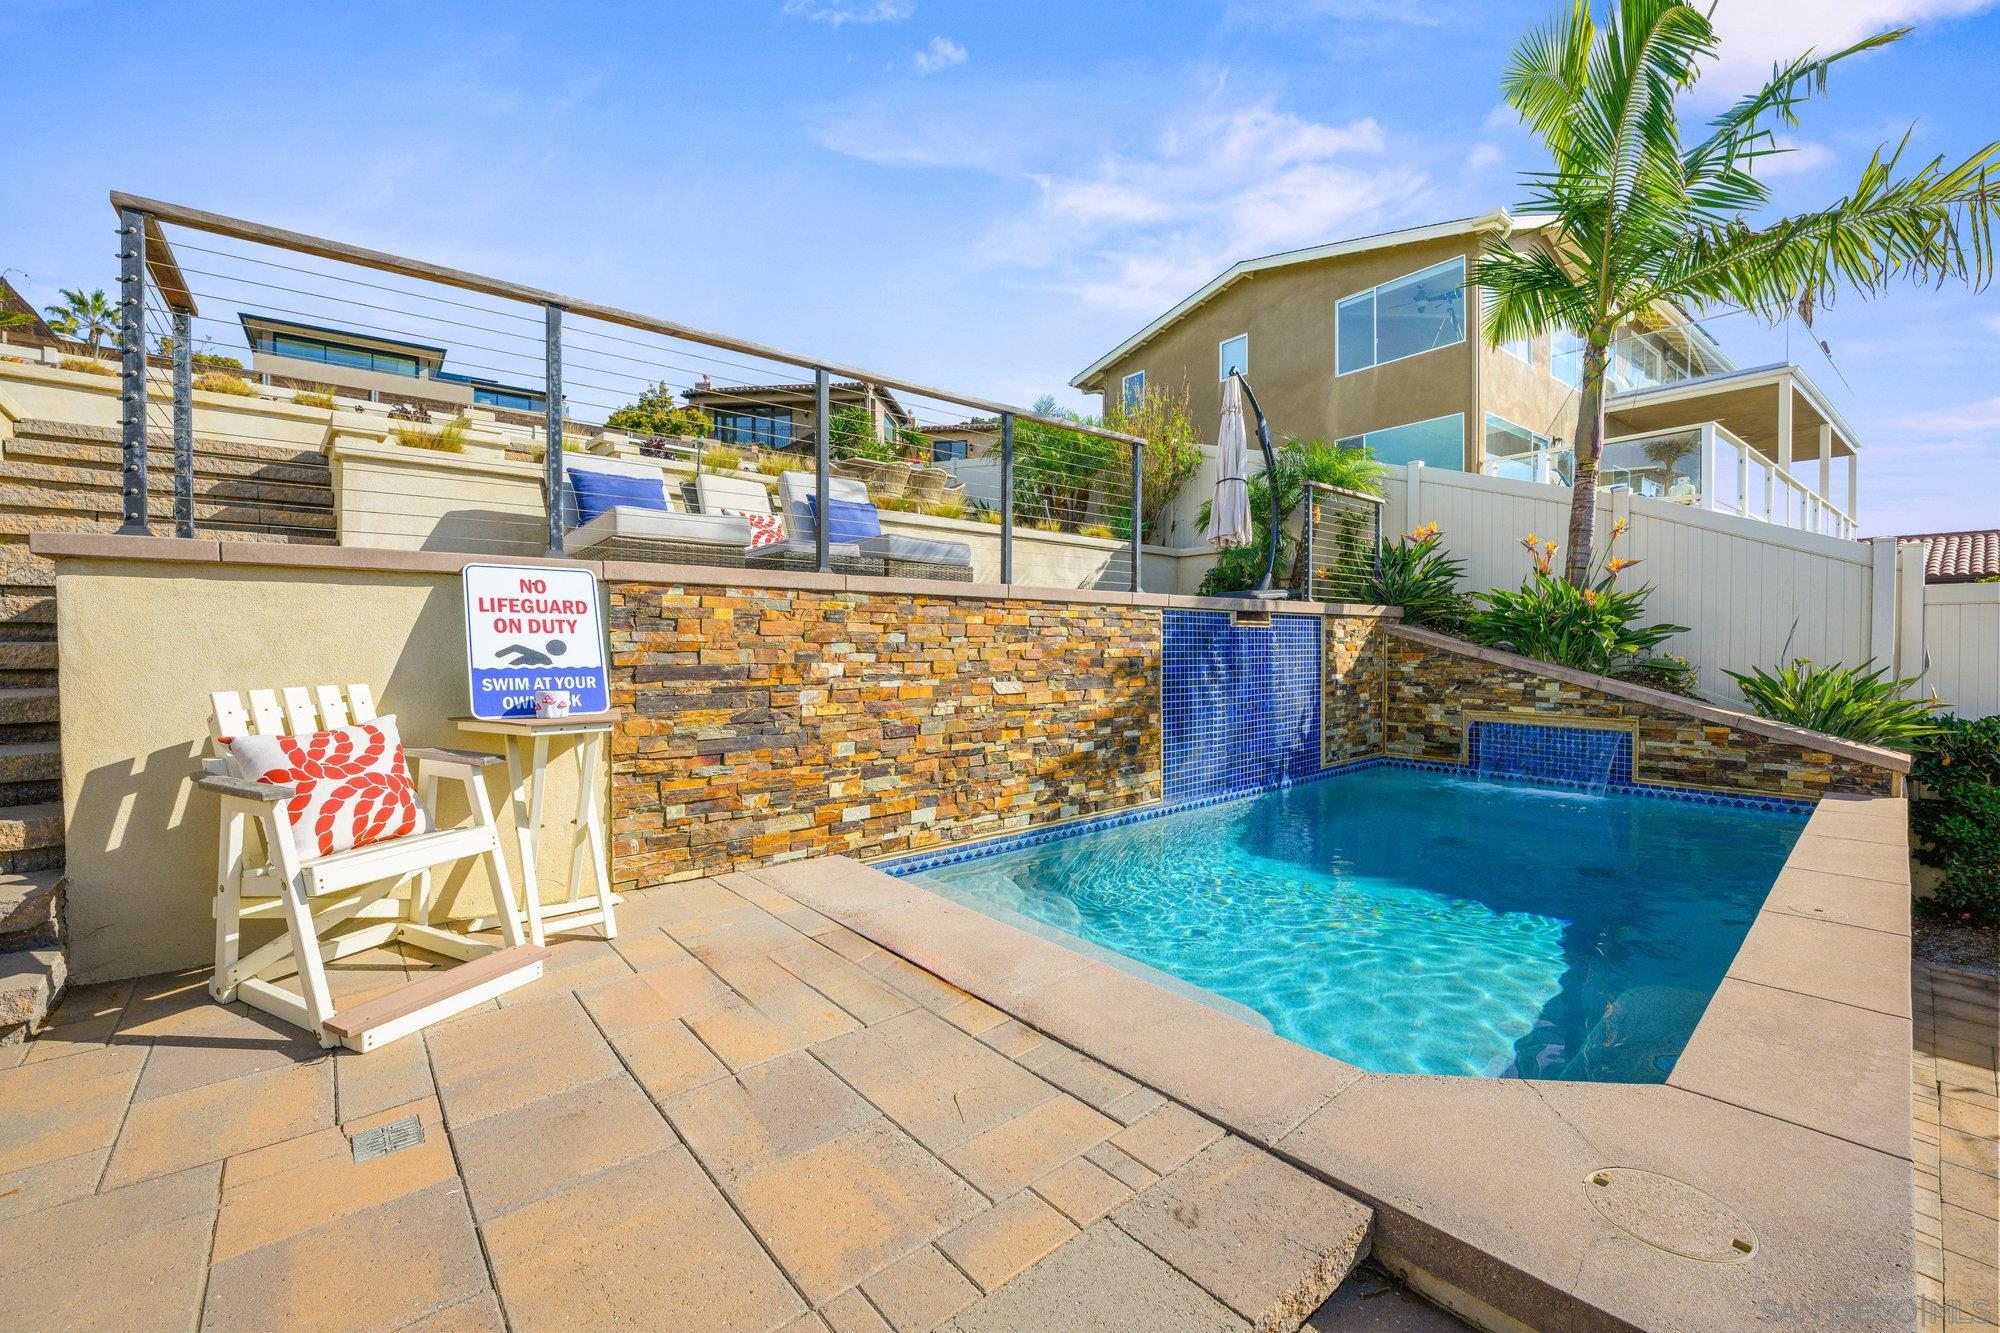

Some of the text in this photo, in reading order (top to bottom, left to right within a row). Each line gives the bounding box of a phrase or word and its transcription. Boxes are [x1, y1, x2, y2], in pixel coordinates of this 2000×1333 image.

[519, 579, 547, 594] NO
[478, 597, 588, 615] LIFEGUARD
[493, 618, 578, 634] ON DUTY
[482, 676, 597, 692] SWIM AT YOUR
